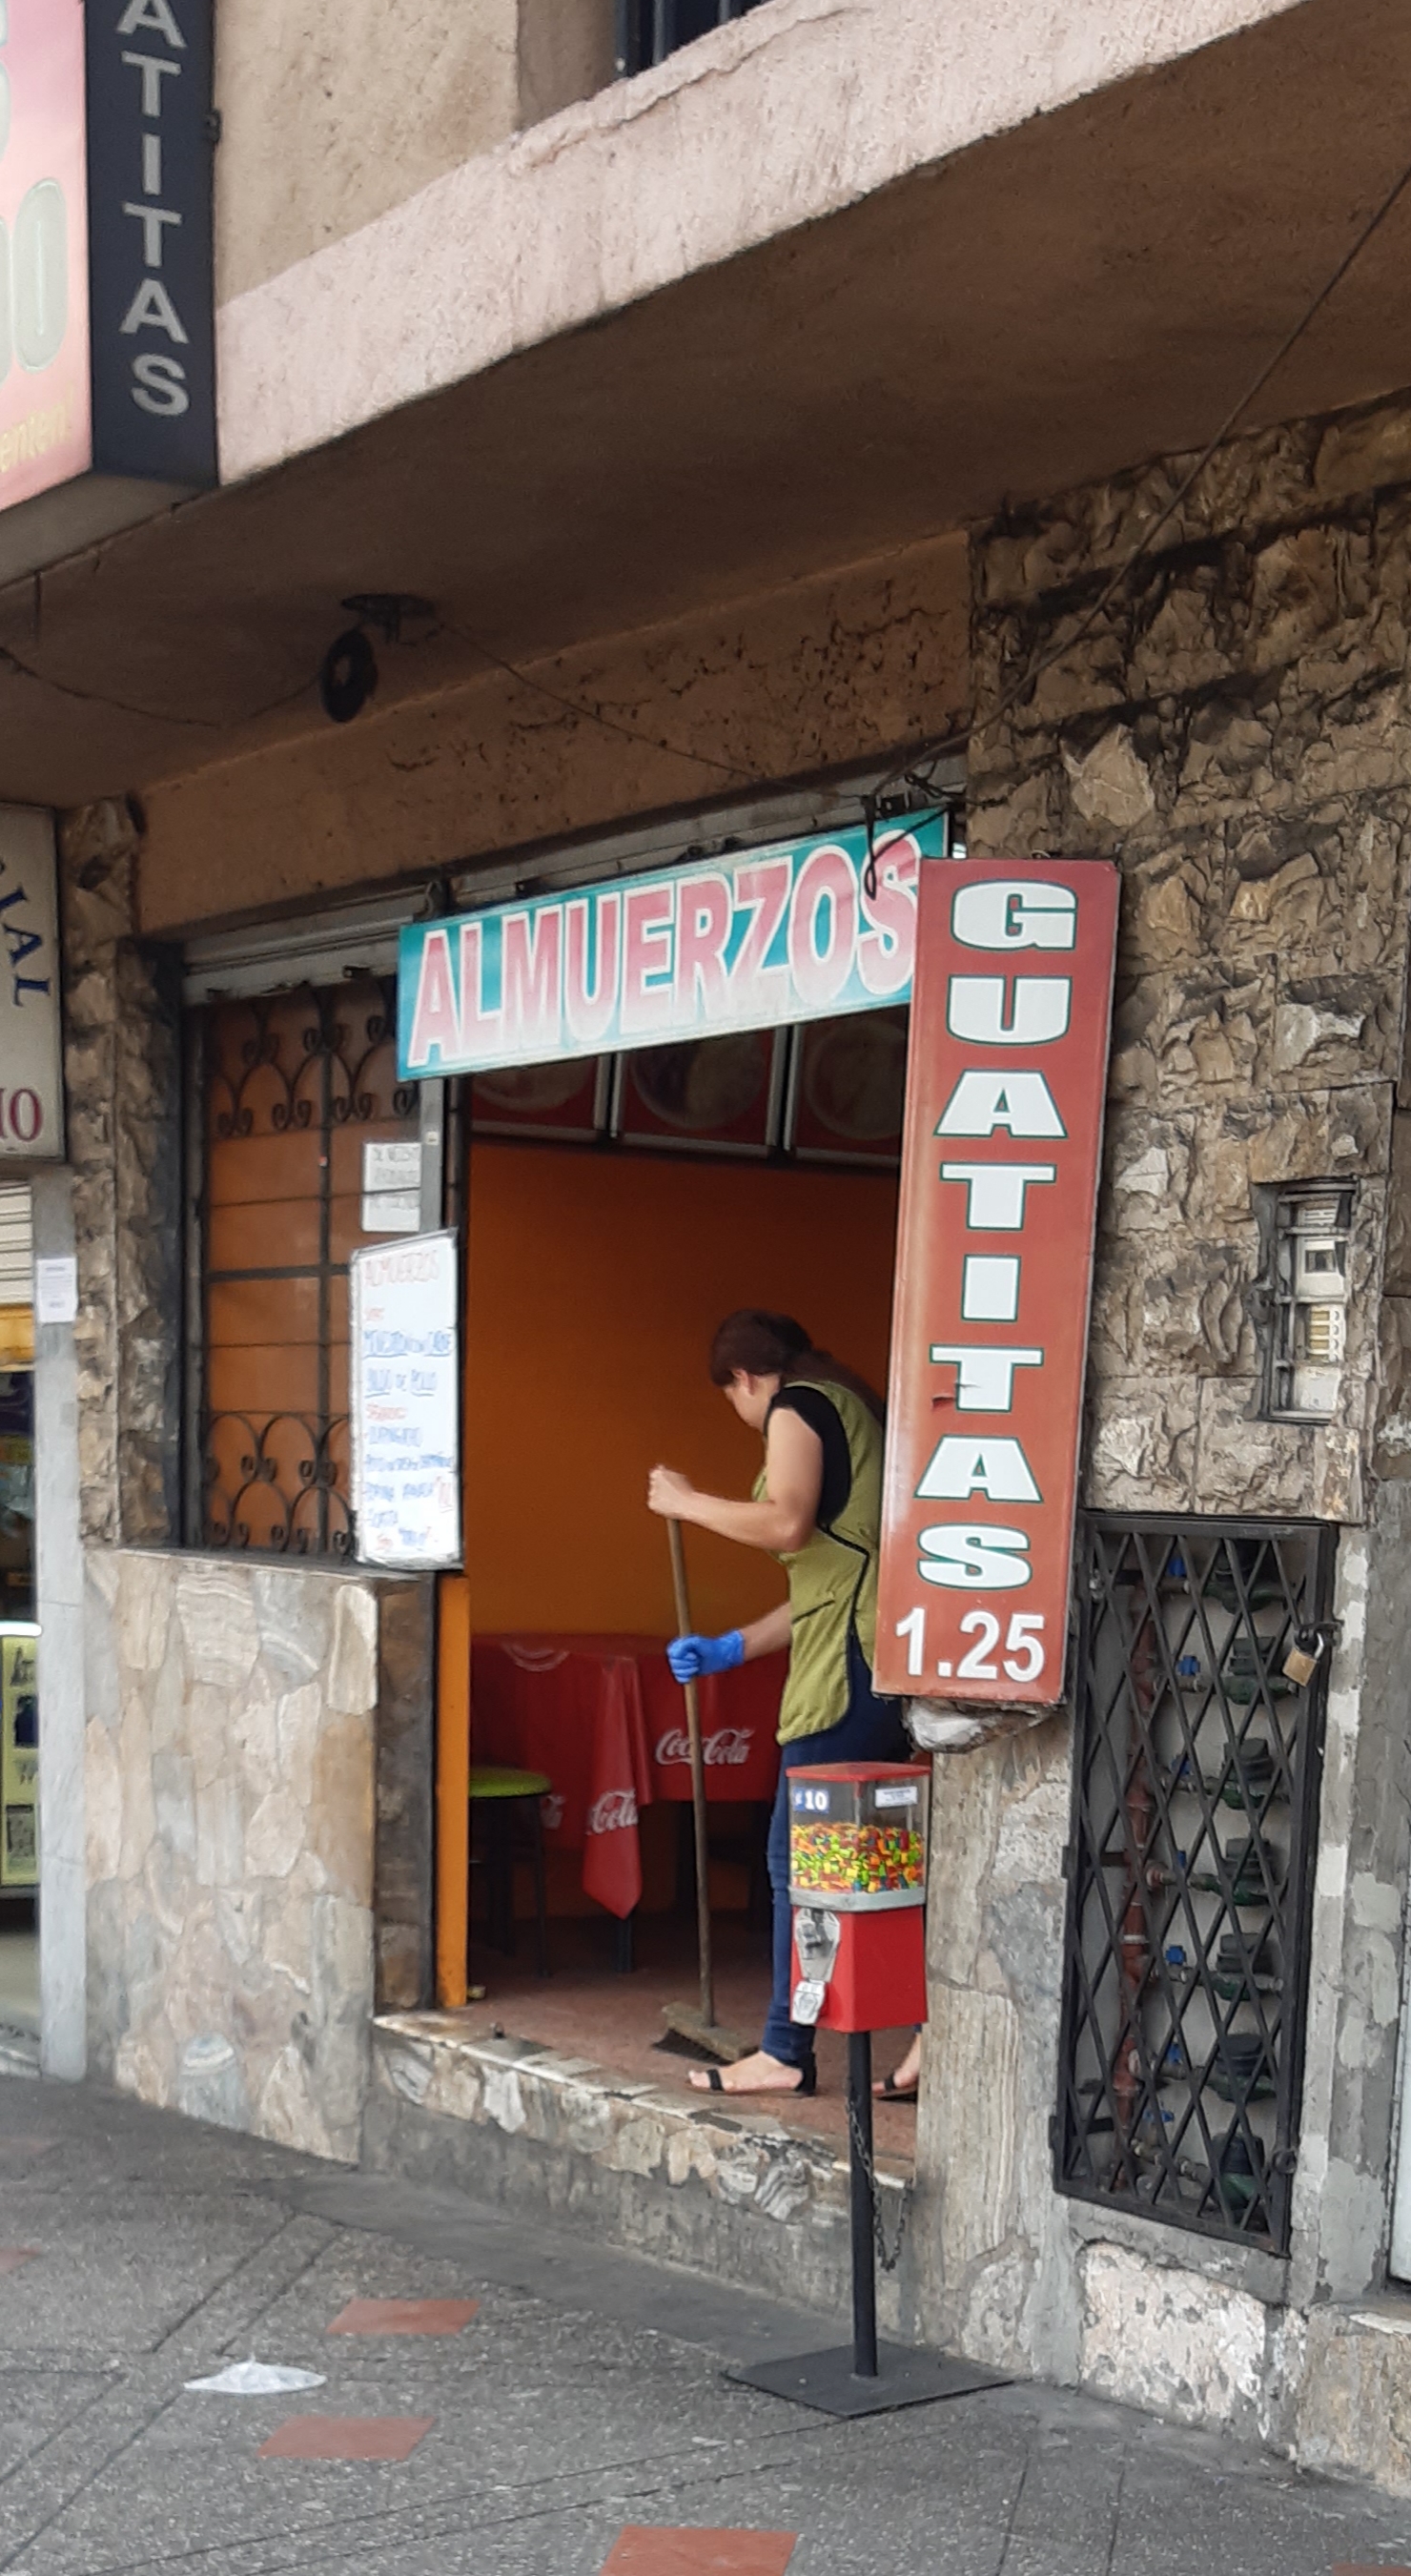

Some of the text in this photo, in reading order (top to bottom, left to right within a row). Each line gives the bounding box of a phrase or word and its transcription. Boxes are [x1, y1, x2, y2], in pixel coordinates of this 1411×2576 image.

[407, 829, 921, 1069] ALMUERZOS
[914, 880, 1078, 1590] GUATITAS
[895, 1607, 1045, 1682] 1.25
